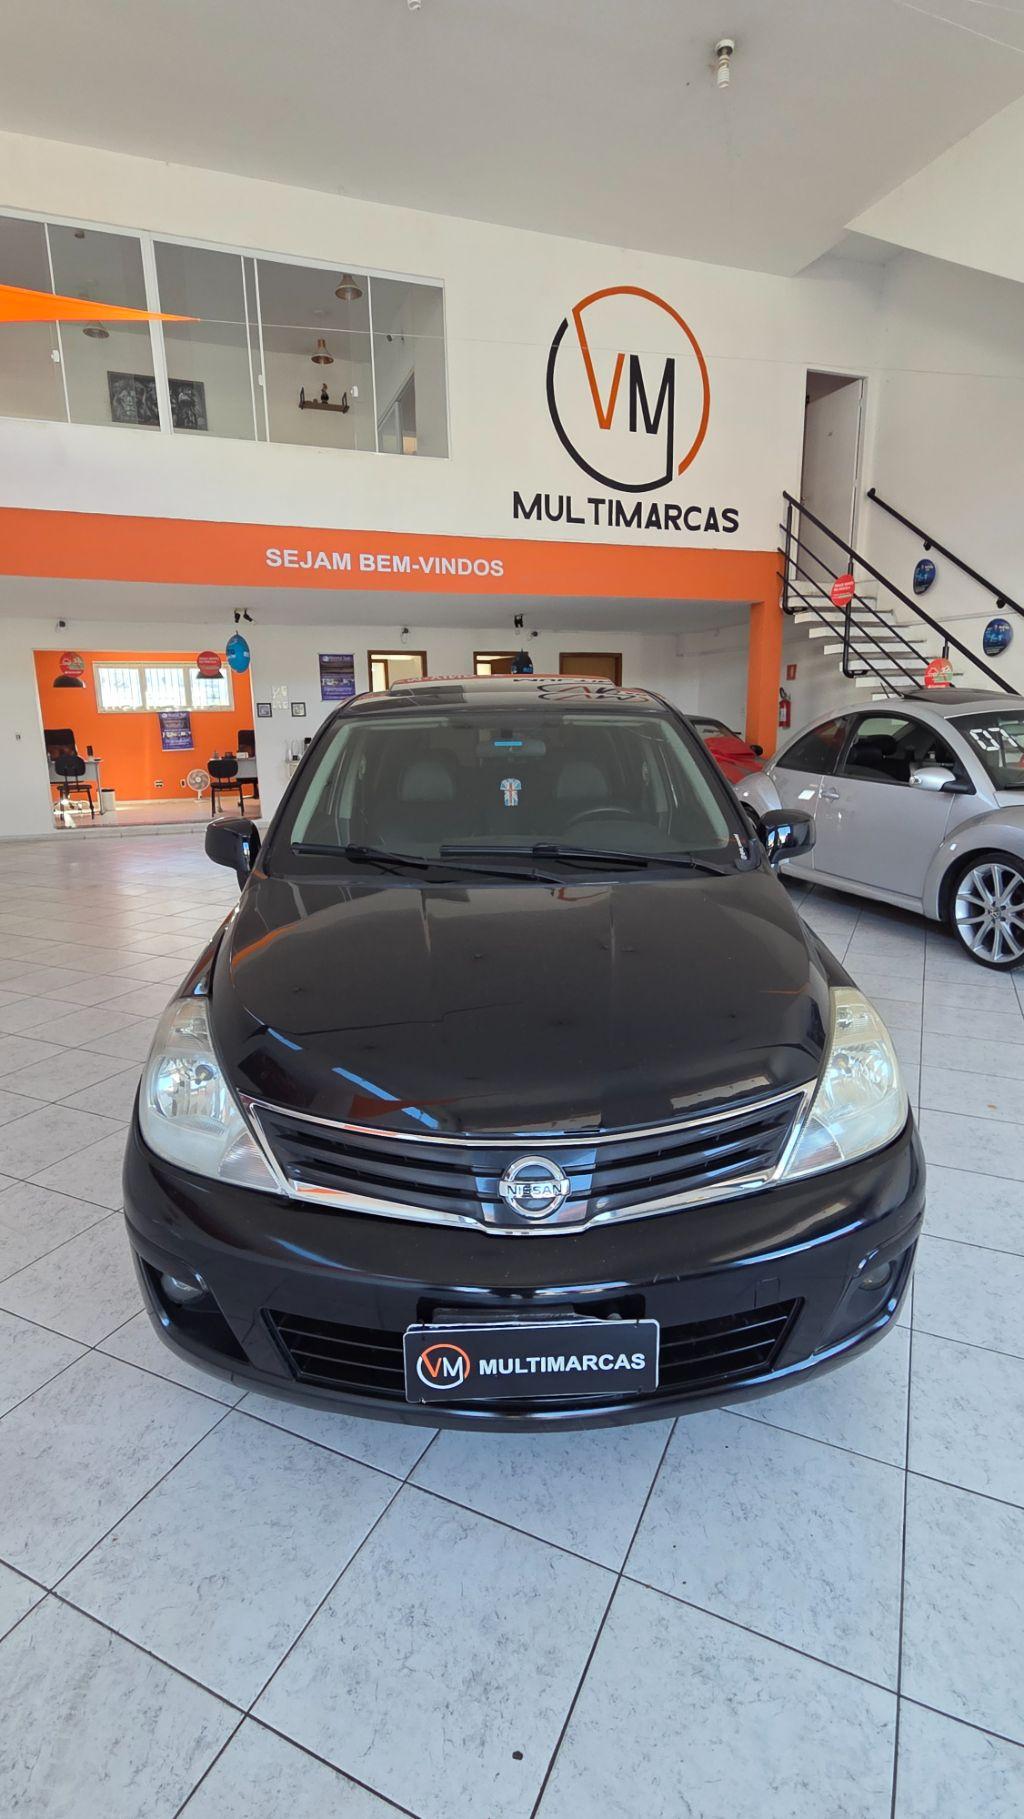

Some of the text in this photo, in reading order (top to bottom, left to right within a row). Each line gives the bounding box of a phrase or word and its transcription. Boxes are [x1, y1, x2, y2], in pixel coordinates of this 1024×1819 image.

[513, 491, 739, 533] MULTIMARCAS
[266, 548, 505, 577] SEJAM BEM-VINDOS
[507, 1184, 562, 1196] NISSAN
[479, 1354, 646, 1375] MULTIMARCAS
